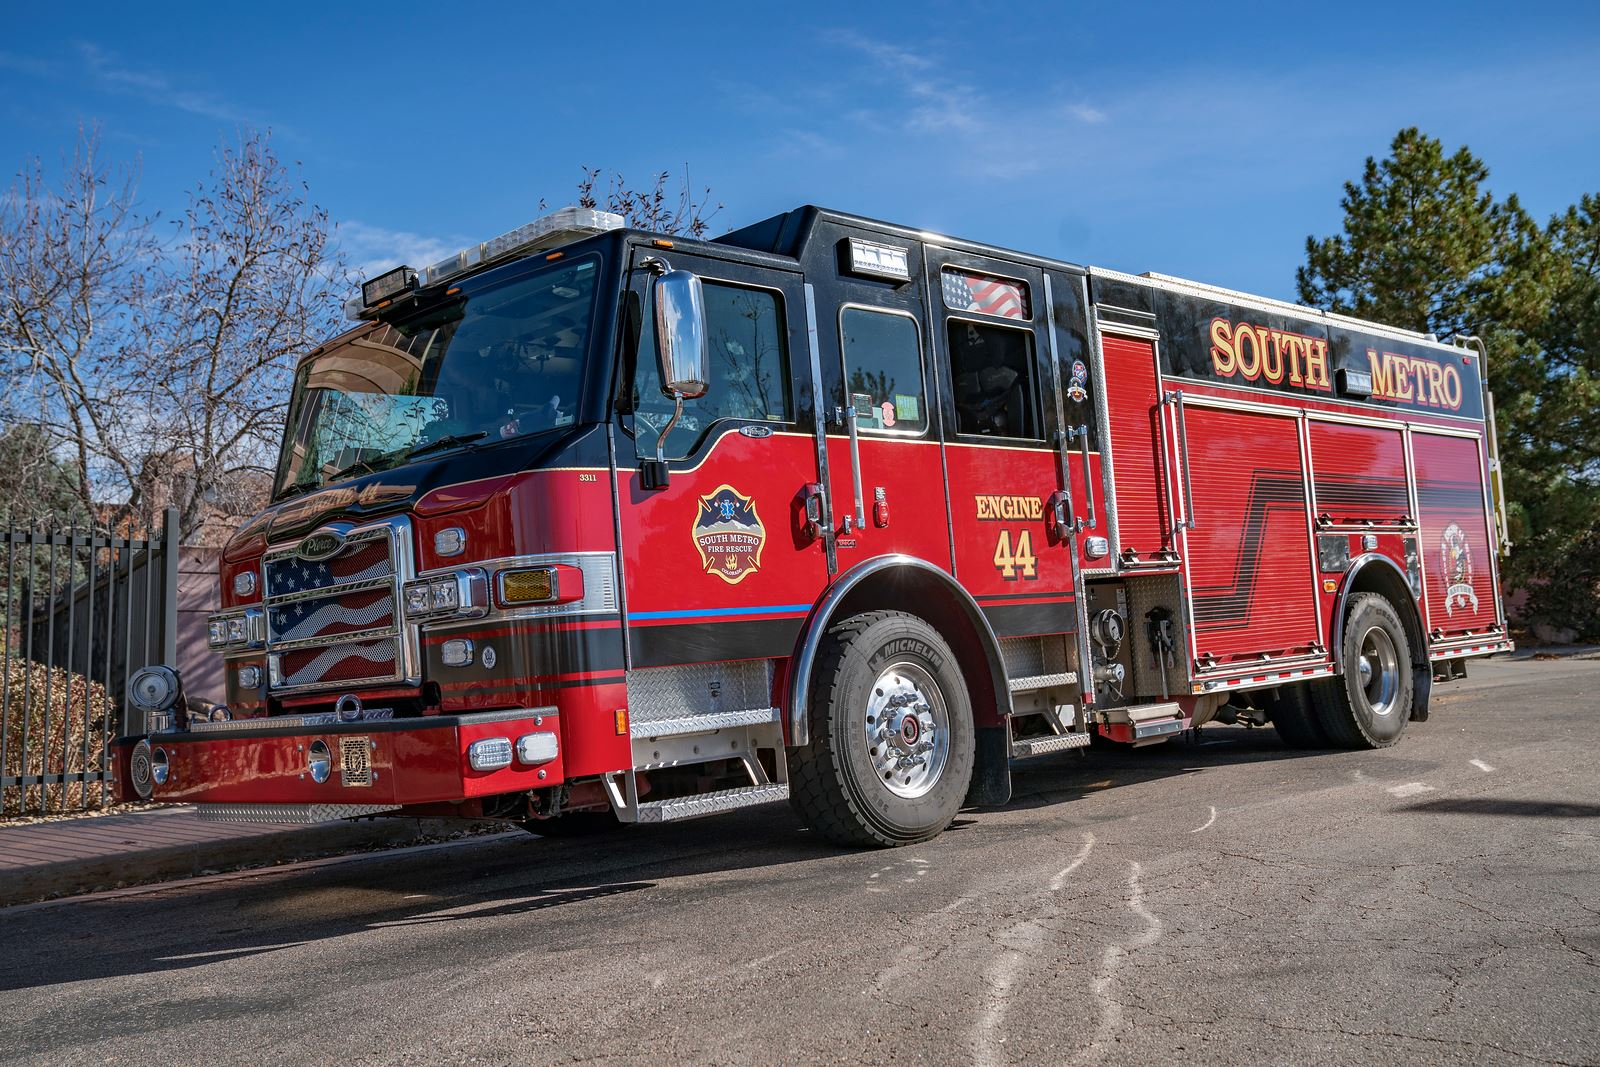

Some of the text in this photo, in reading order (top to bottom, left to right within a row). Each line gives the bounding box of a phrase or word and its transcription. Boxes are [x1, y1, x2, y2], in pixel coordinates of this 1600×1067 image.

[1210, 317, 1463, 411] SOUTH METRO
[579, 474, 597, 482] 3311
[975, 494, 1043, 521] ENGINE
[700, 534, 760, 547] SOUTH METRO
[707, 545, 753, 553] FIRE RESCUE
[993, 528, 1038, 581] 44
[721, 567, 743, 576] COLORADO
[884, 639, 944, 668] MICHELIN
